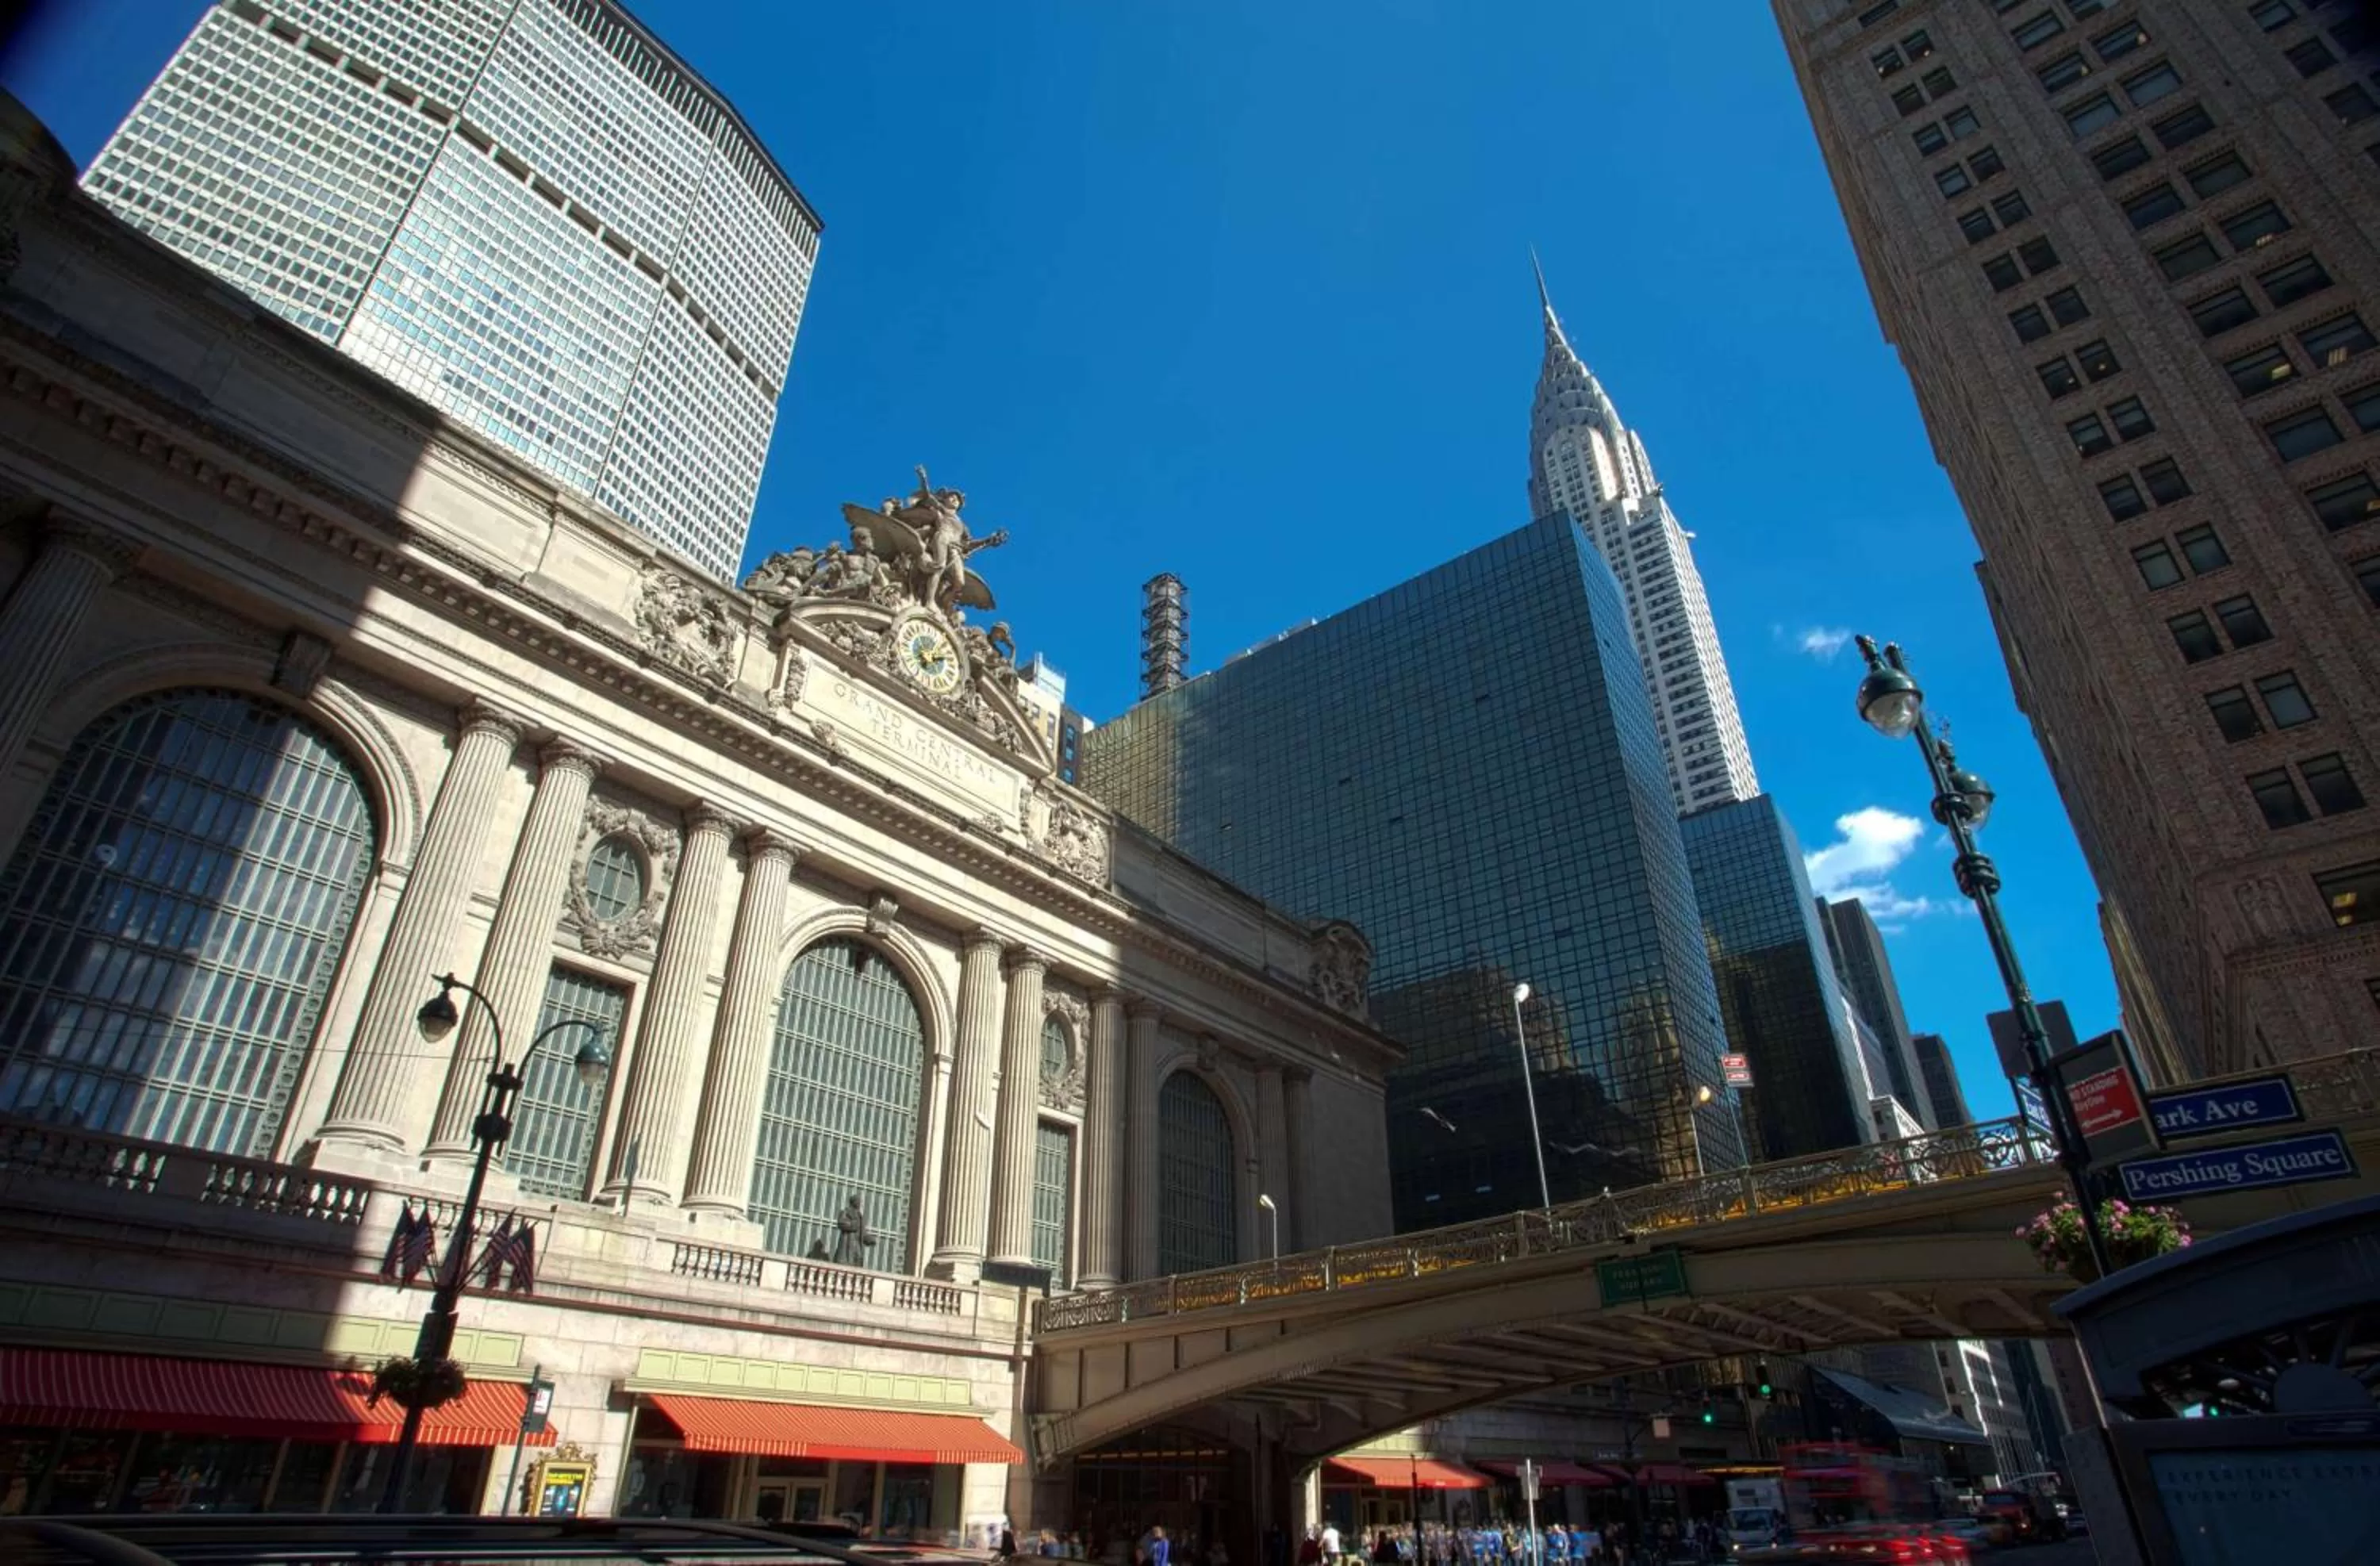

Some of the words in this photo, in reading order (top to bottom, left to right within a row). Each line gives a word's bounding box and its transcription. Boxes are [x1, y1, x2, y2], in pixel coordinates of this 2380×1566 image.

[834, 682, 903, 729] GRAND
[916, 729, 996, 783] CENTRAL
[871, 718, 962, 780] TERMINAL
[2155, 1107, 2197, 1129] ark
[2205, 1097, 2259, 1120] Ave
[2127, 1158, 2243, 1191] Pershing
[2244, 1149, 2342, 1178] Square
